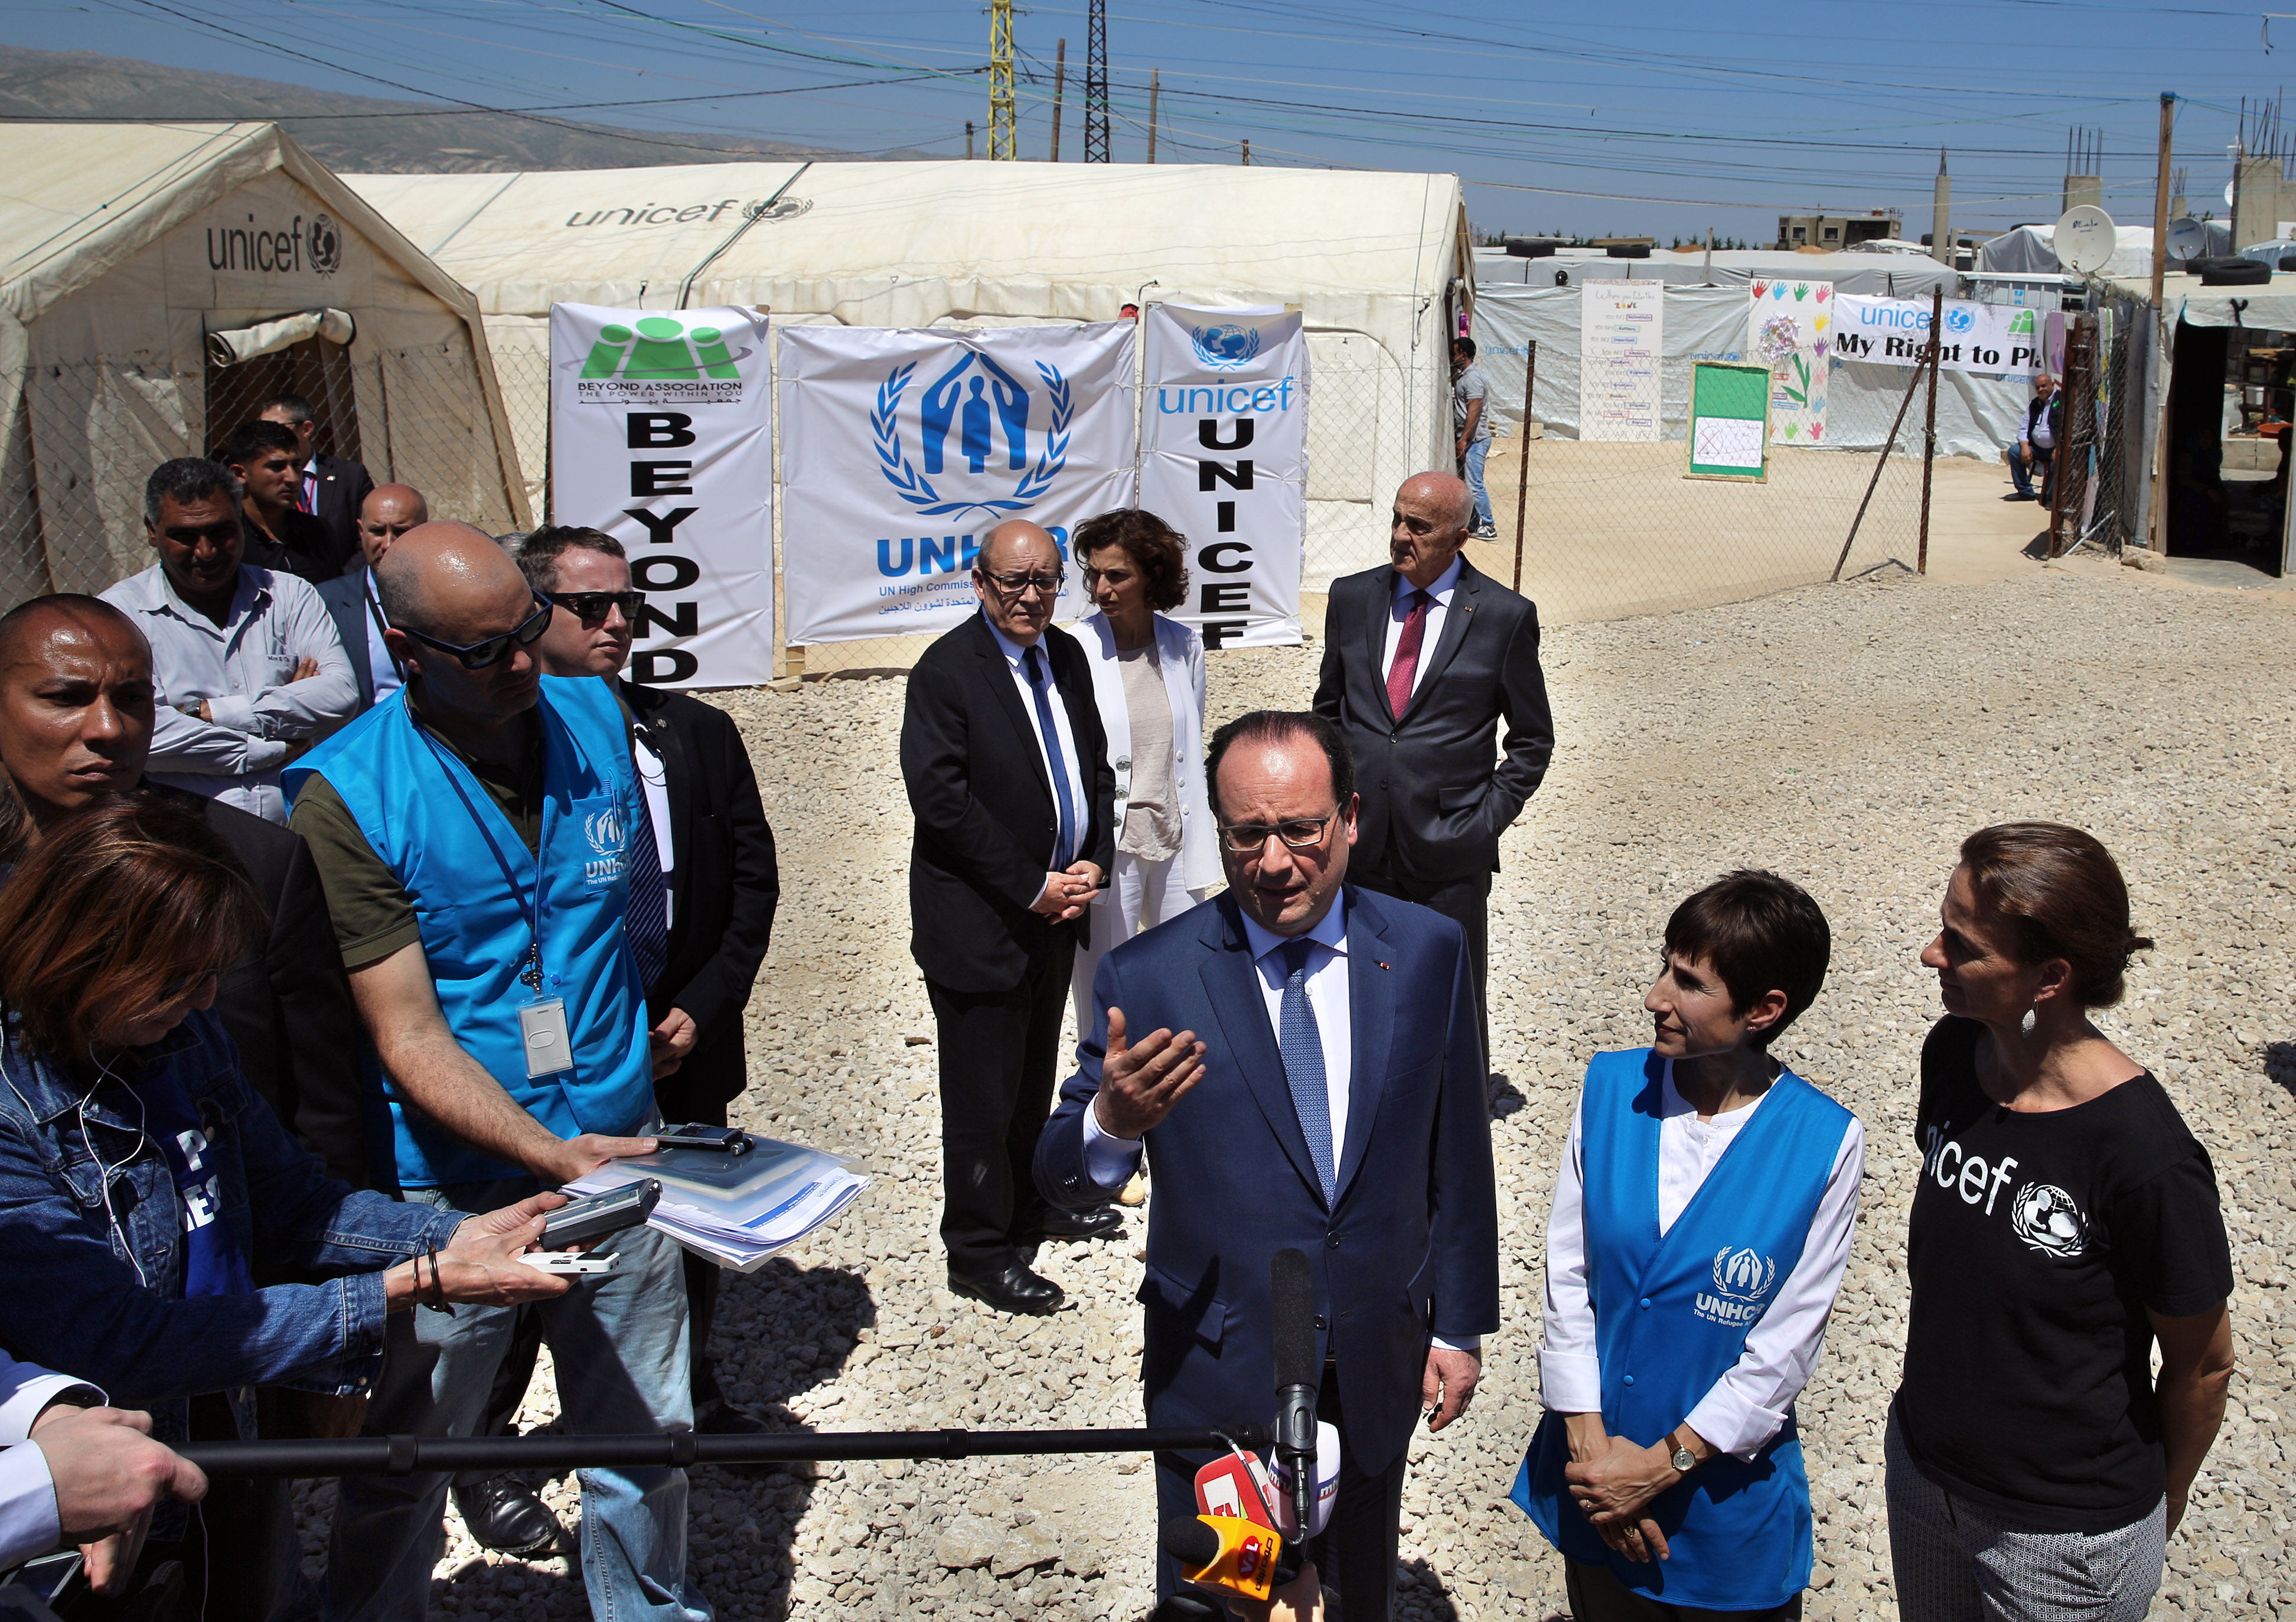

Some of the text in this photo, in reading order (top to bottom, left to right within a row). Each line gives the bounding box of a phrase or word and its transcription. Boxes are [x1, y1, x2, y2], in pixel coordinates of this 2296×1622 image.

[566, 199, 739, 227] unicef
[208, 213, 302, 272] unicef
[1861, 303, 1931, 330] unice
[1837, 333, 1875, 359] My
[1972, 345, 2000, 365] to
[2011, 347, 2042, 369] Pla
[578, 382, 742, 391] BEYOND ASSOCIATION
[1159, 376, 1294, 414] unicef
[622, 412, 700, 684] BEYOND
[1198, 417, 1254, 650] UNICEF
[879, 579, 974, 596] UN High Commiss
[1924, 1120, 2019, 1216] nicef
[1694, 1308, 1705, 1318] The
[1707, 1314, 1717, 1322] UN
[1718, 1318, 1744, 1327] Refugee
[1696, 1292, 1766, 1321] UNHCR
